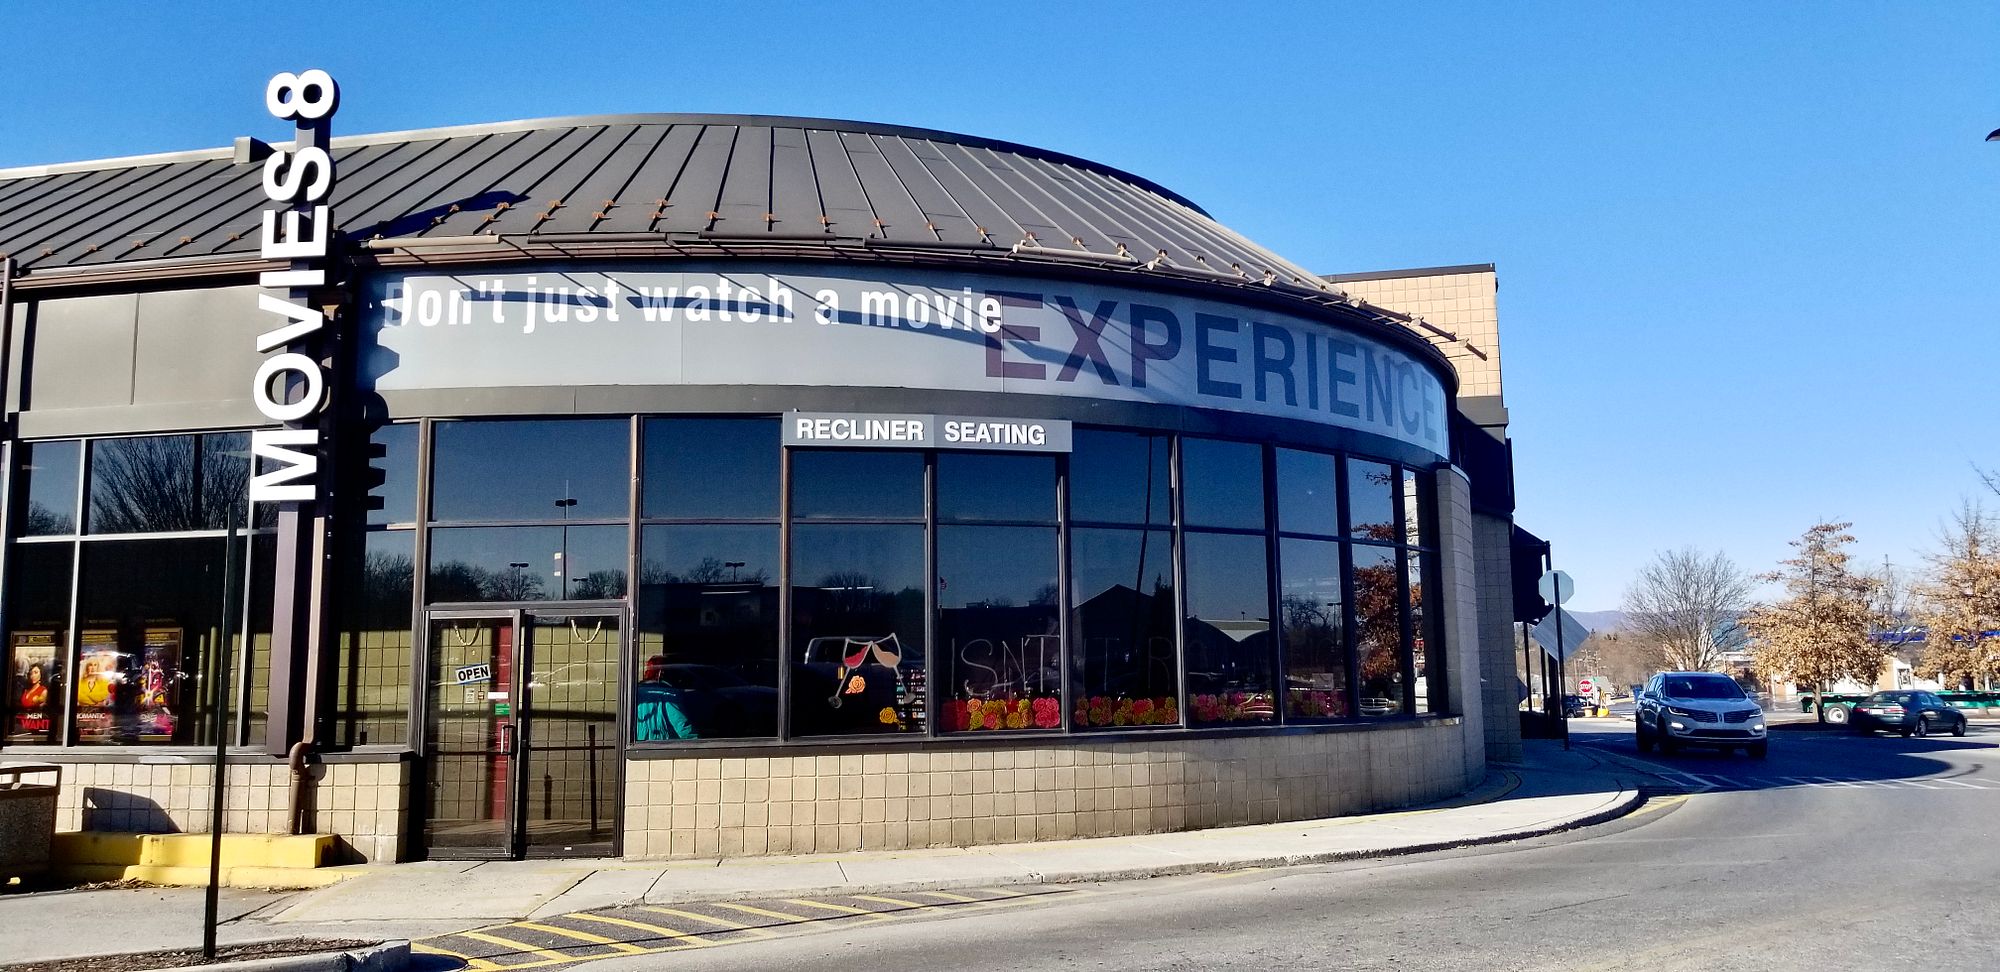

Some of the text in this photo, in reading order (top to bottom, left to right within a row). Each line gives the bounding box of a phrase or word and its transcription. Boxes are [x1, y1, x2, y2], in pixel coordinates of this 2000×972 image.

[249, 69, 337, 501] MOVIES 8
[384, 276, 1001, 334] Don't just watch a movie
[985, 289, 1438, 443] EXPERIENCE
[797, 419, 1048, 445] RECLINER SEATING
[457, 665, 489, 682] OPEN
[21, 719, 50, 730] WANT
